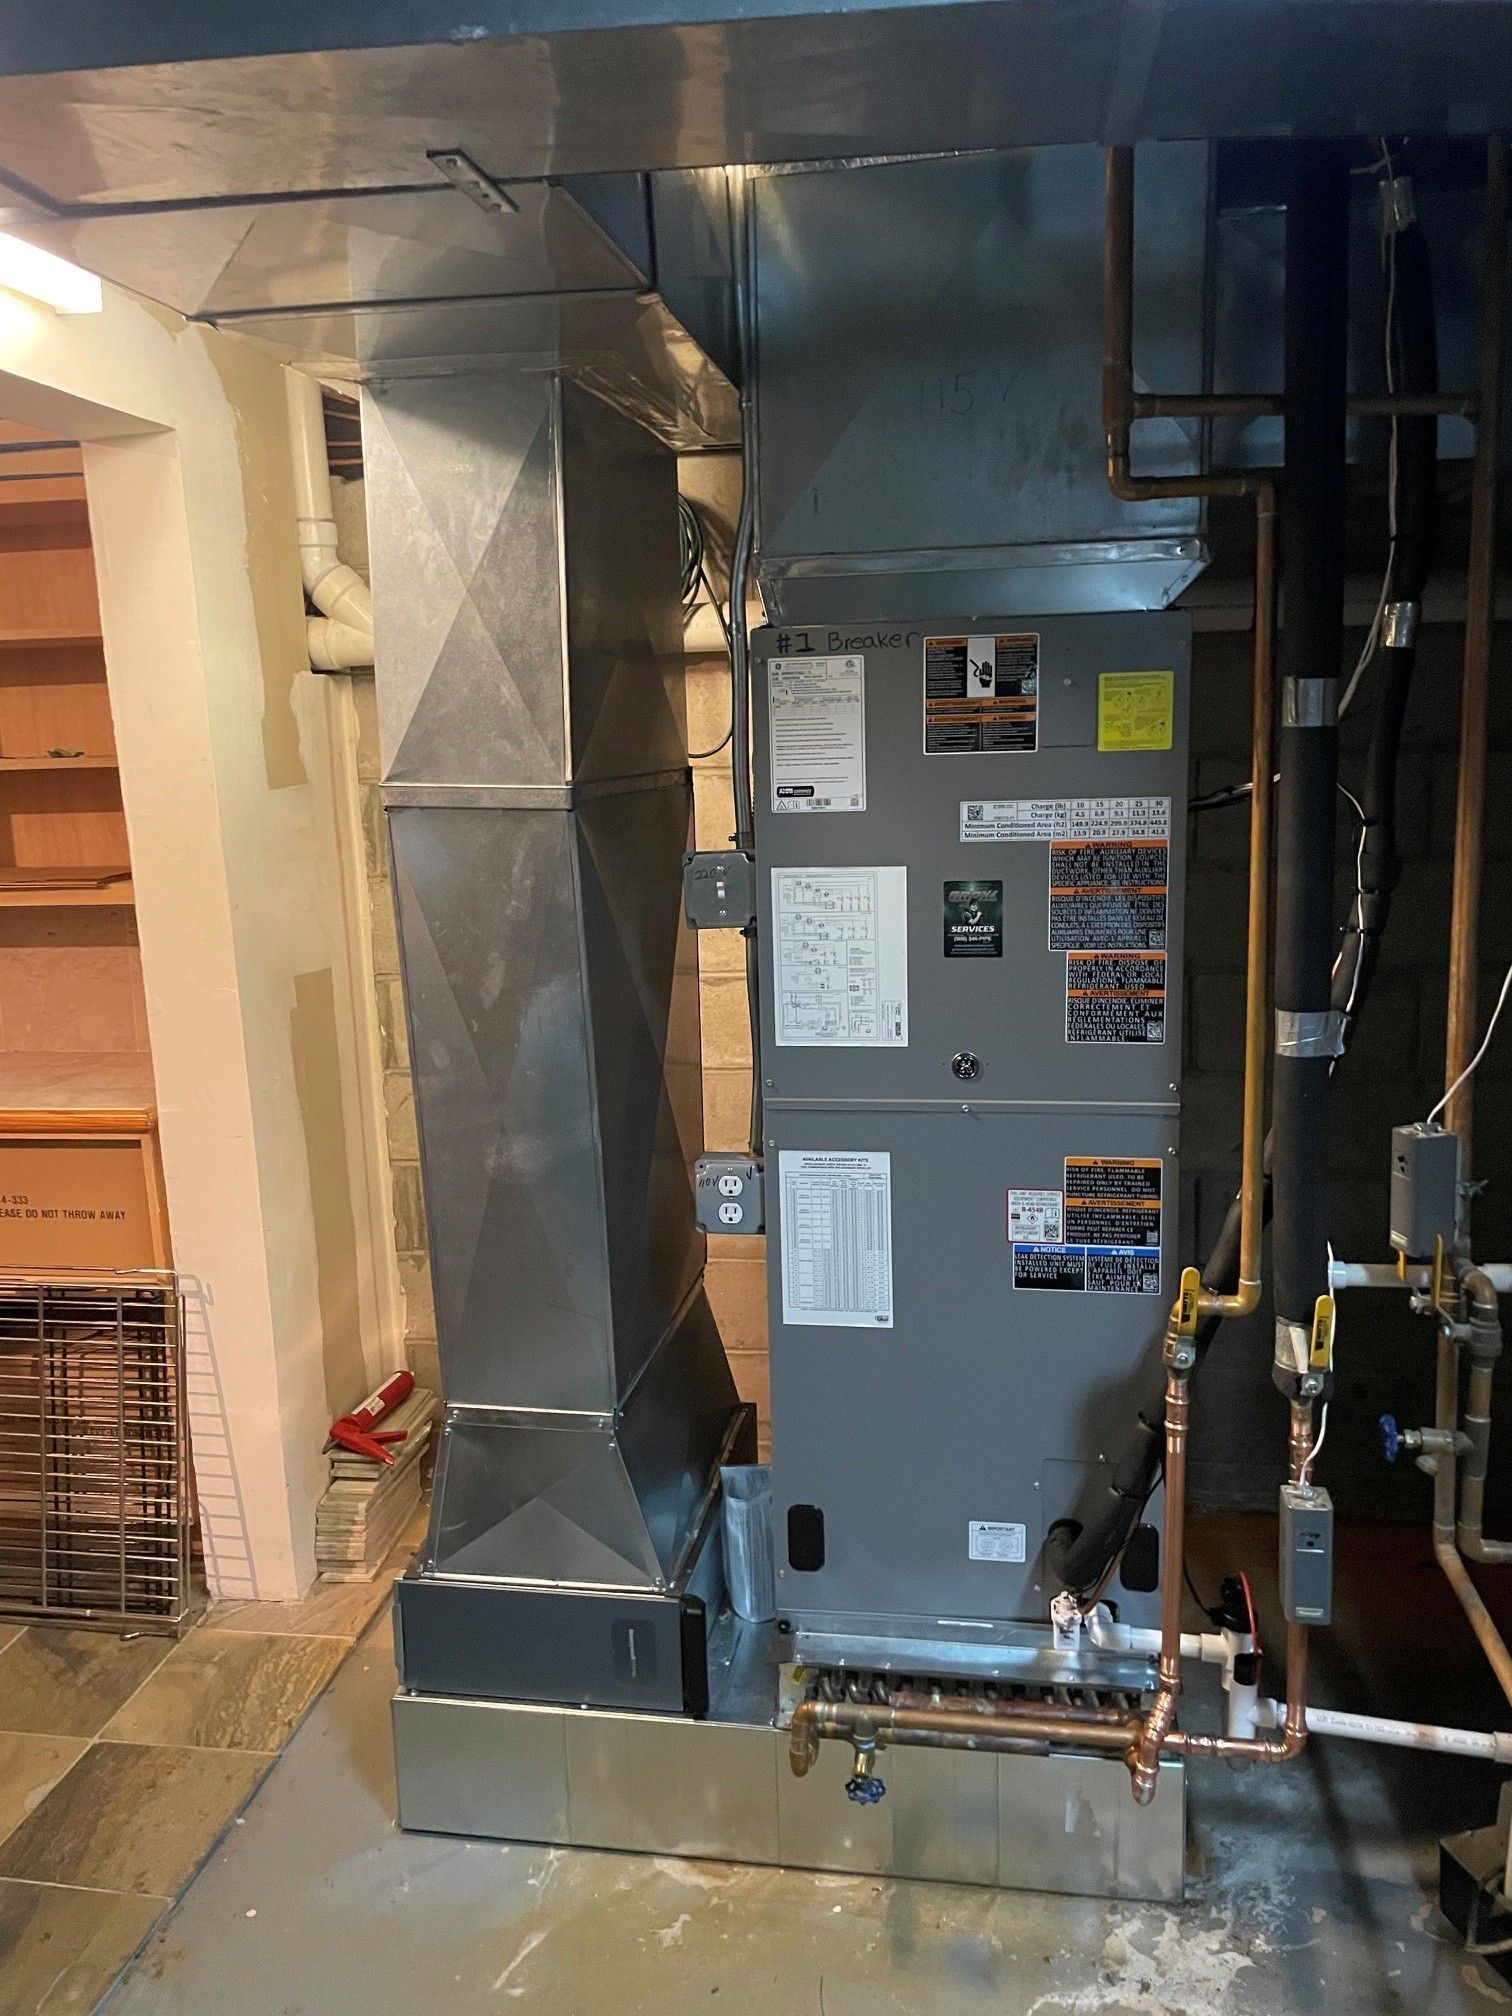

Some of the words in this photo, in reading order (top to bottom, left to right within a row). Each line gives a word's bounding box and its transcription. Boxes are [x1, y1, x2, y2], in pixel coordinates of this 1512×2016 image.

[776, 632, 815, 654] #1
[828, 632, 919, 651] Breaker
[1054, 811, 1066, 819] (kg)
[26, 1209, 38, 1218] DO
[42, 1209, 58, 1218] NOT
[63, 1210, 96, 1220] THROW
[100, 1211, 125, 1220] AWAY
